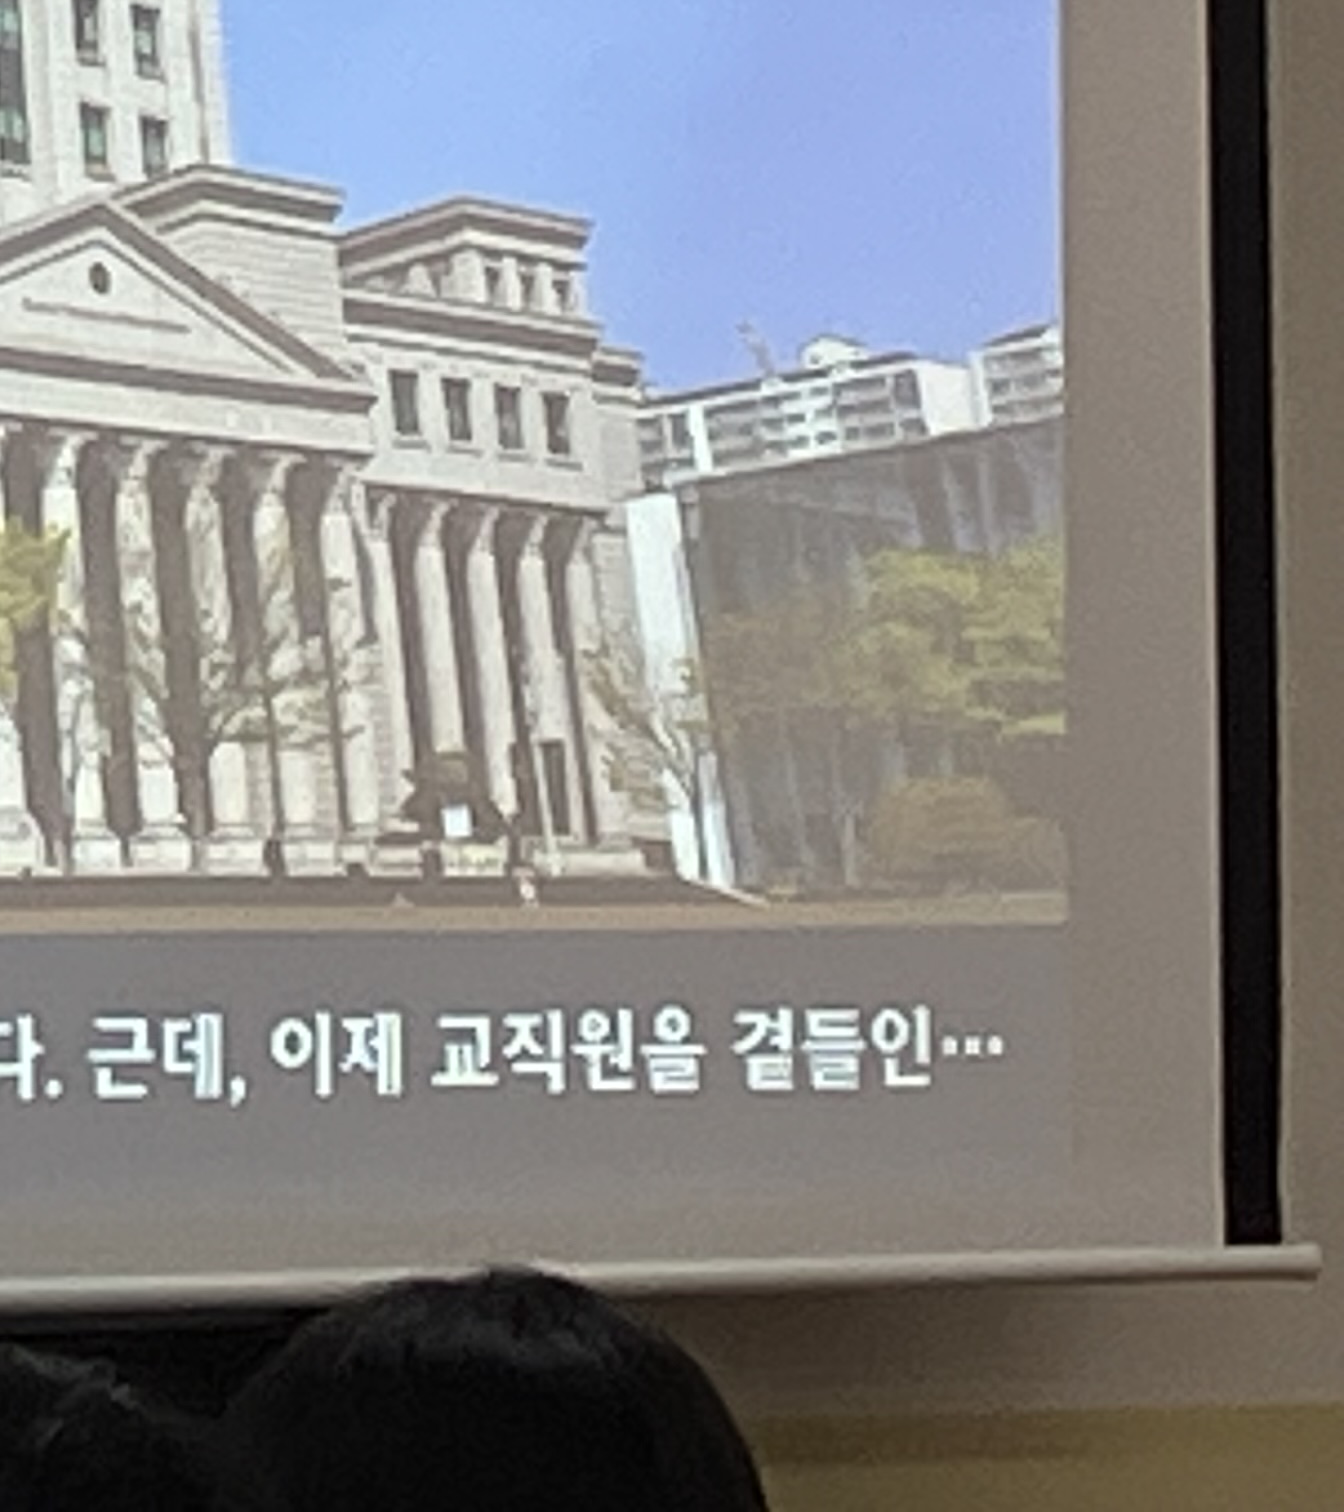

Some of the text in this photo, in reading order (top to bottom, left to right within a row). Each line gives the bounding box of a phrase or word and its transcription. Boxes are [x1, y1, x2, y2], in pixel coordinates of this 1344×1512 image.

[86, 1012, 247, 1107] 근데,
[270, 1010, 403, 1099] 이제
[430, 1005, 708, 1095] 교직원을
